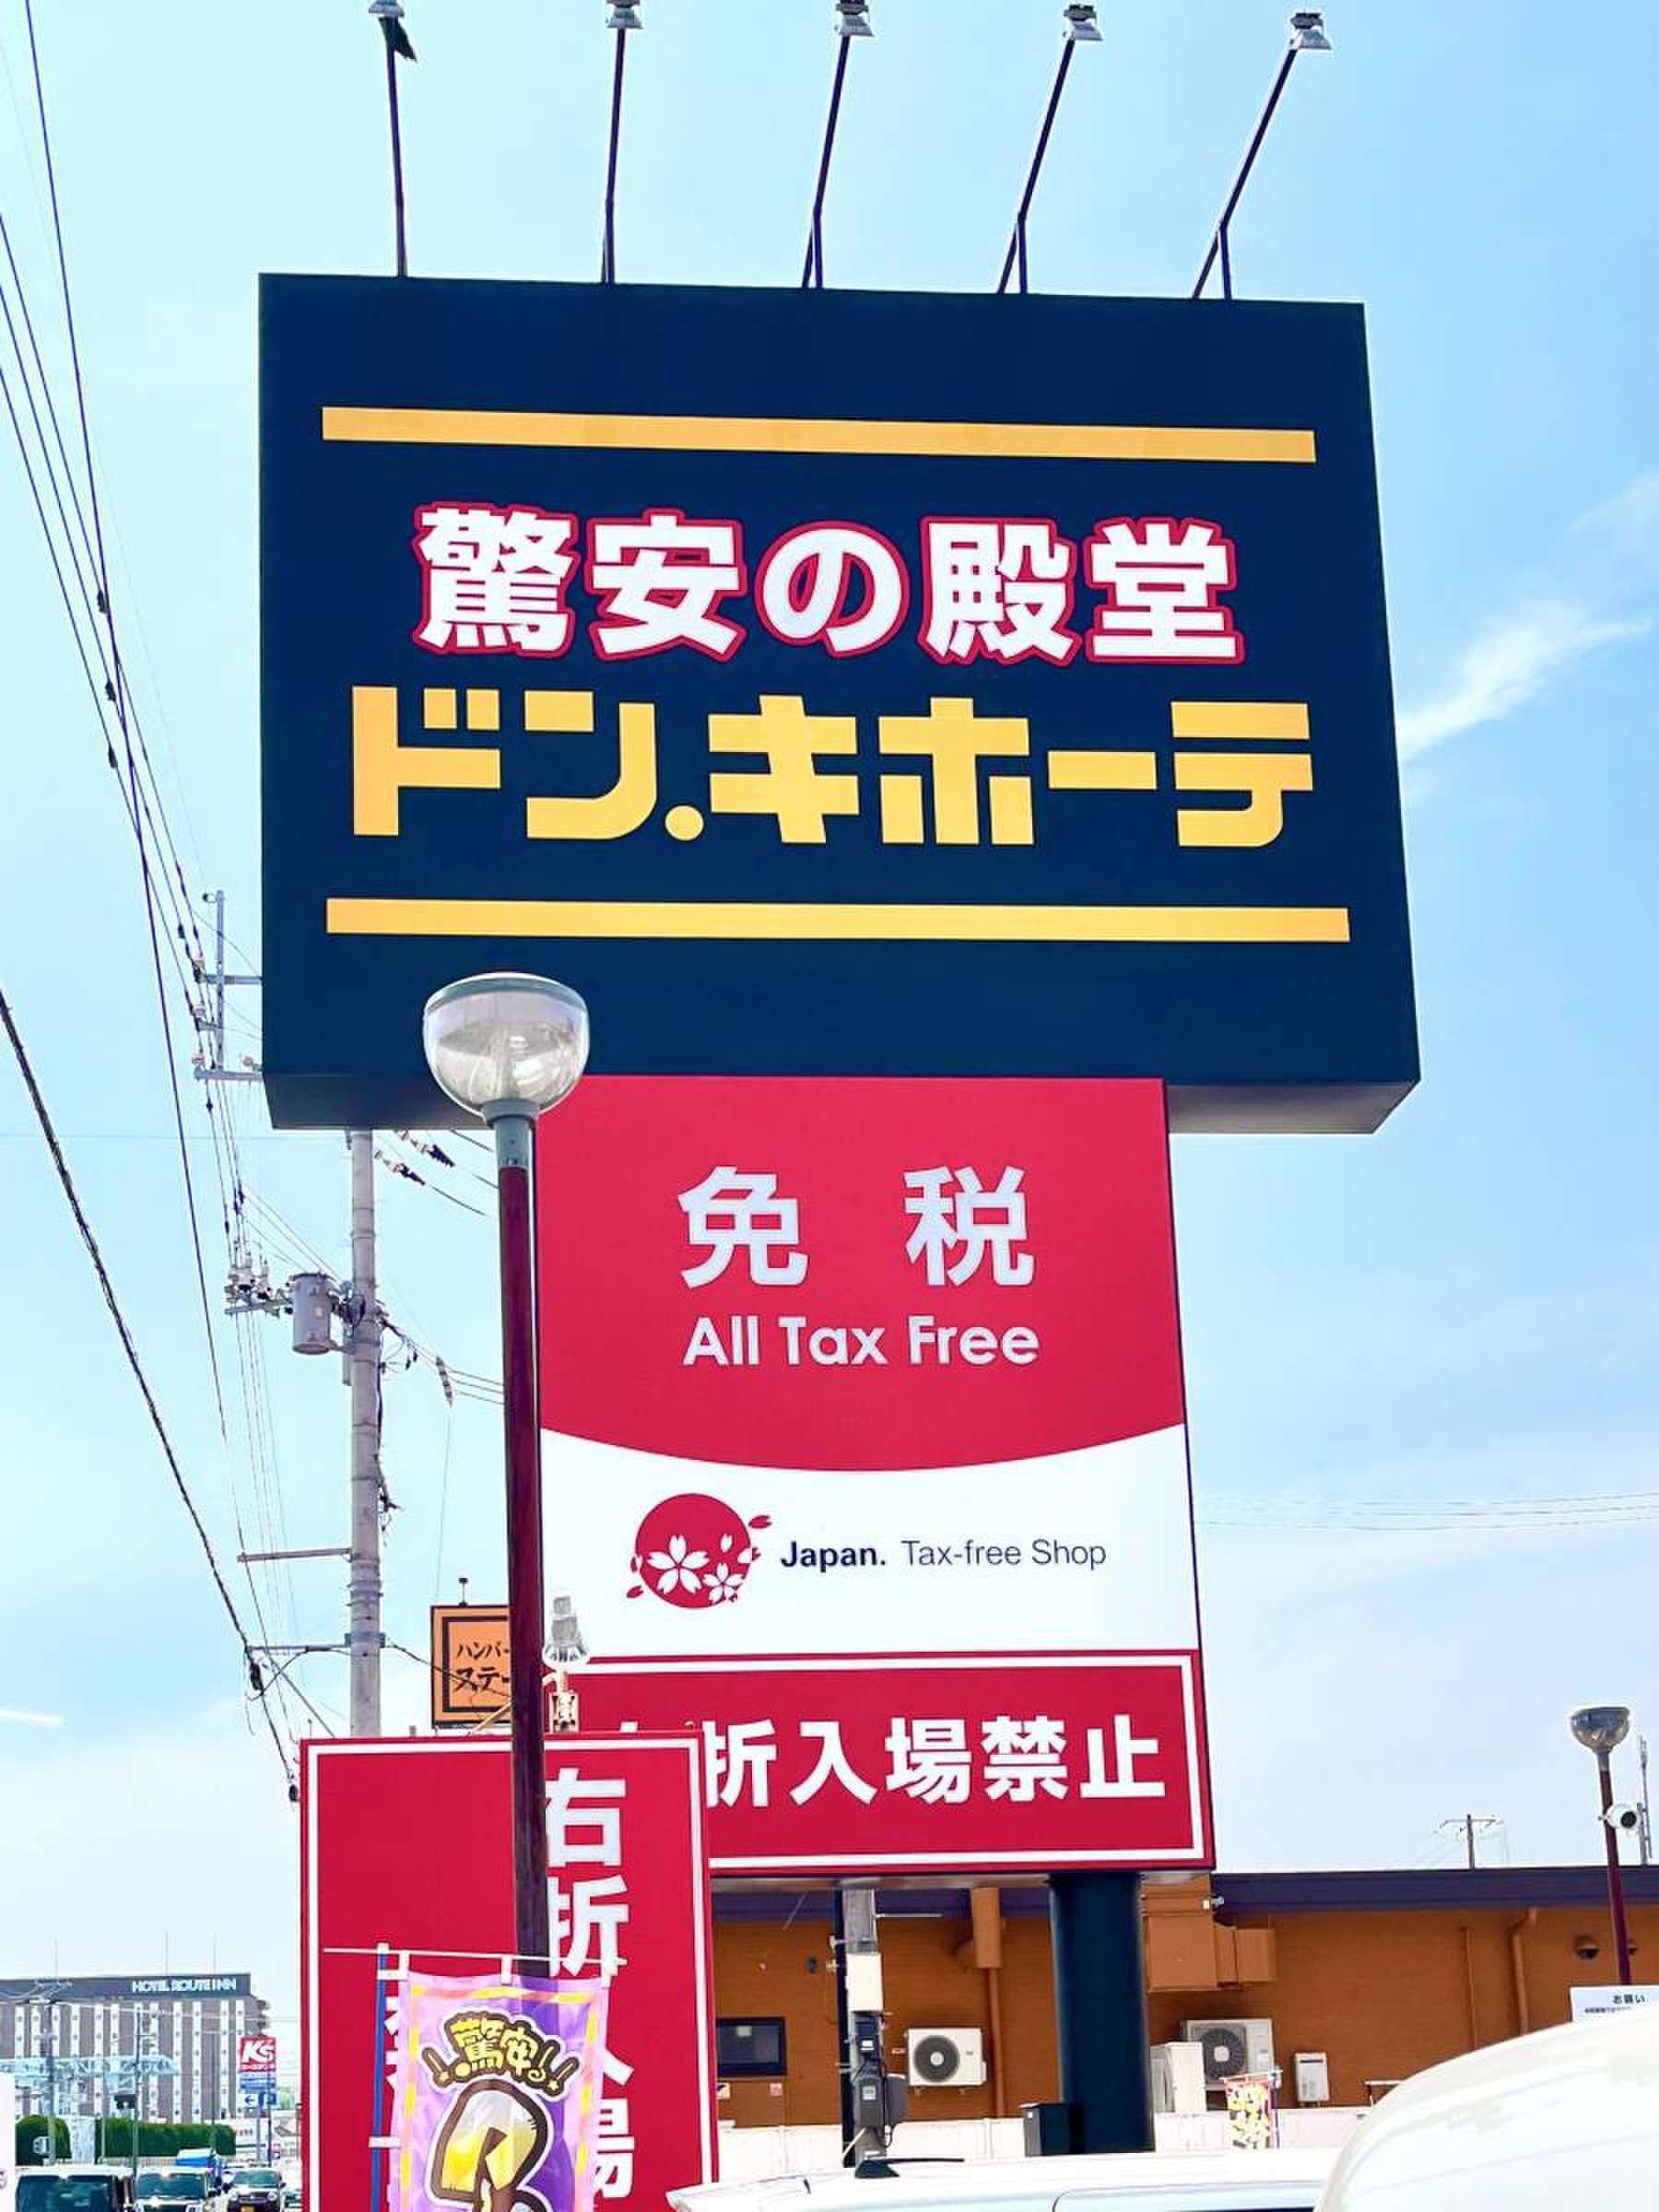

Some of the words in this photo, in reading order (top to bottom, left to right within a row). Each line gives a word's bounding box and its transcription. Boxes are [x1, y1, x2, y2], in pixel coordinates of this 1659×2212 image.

[412, 502, 1245, 664] 驚安の殿堂
[677, 1165, 1035, 1289] 免税
[682, 1315, 761, 1368] All
[777, 1315, 888, 1367] Tax
[907, 1314, 1041, 1366] Free
[780, 1540, 887, 1573] Japan.
[900, 1539, 1023, 1568] Tax-free
[1030, 1537, 1107, 1571] Shop
[621, 1714, 1167, 1808] 折入場禁止
[132, 1981, 171, 1993] HOTEL
[212, 1977, 237, 1992] INN
